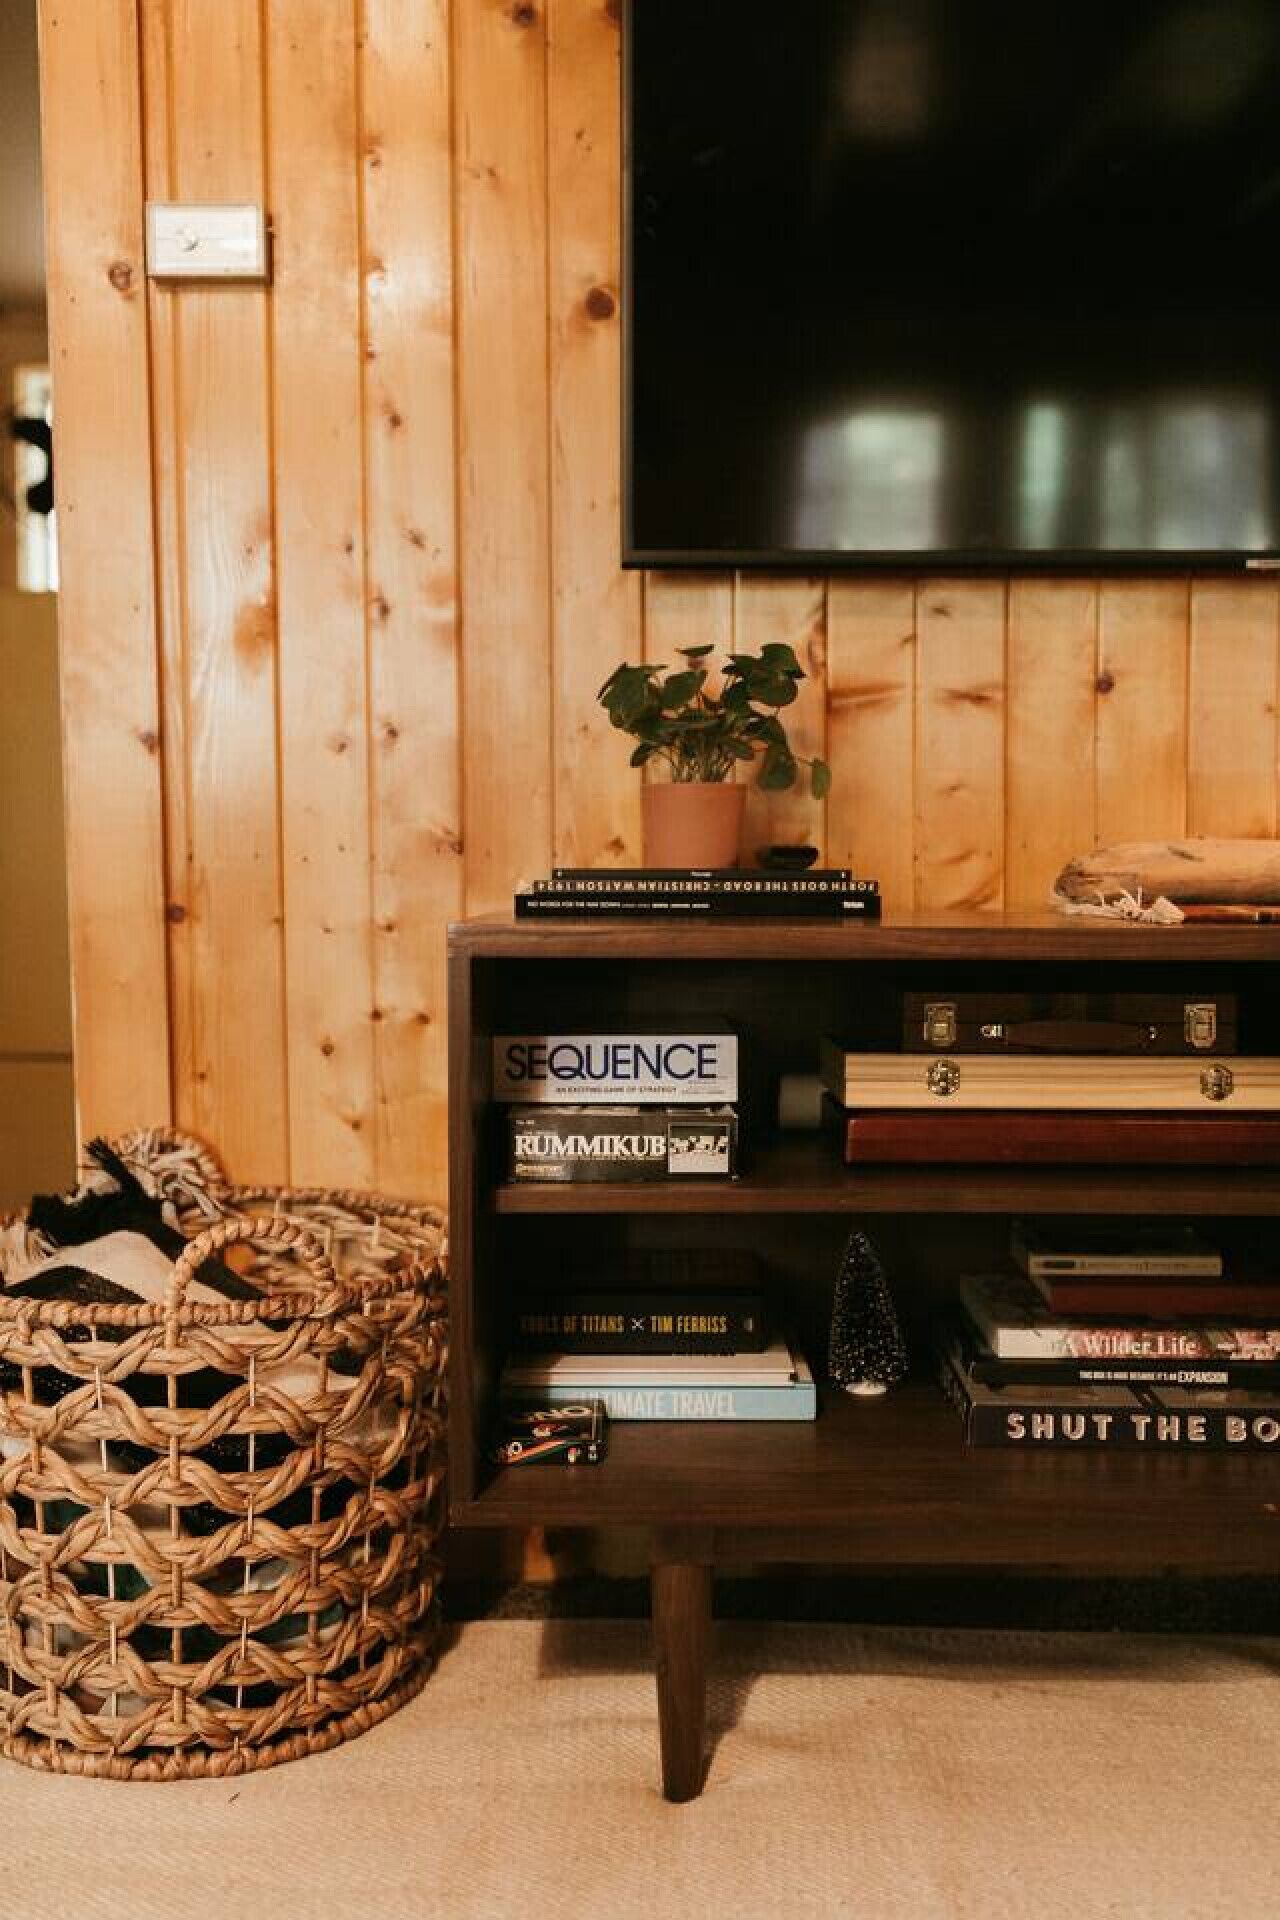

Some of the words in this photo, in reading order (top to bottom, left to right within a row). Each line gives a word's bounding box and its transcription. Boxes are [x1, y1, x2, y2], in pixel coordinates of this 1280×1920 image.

[576, 881, 634, 891] WATSON
[637, 881, 711, 891] CHRISTIAN
[724, 881, 761, 891] ROAD
[766, 881, 787, 891] THE
[505, 1043, 718, 1080] SEQUENCE
[514, 1135, 667, 1156] RUMMIKUB
[582, 1315, 625, 1333] TITANS
[651, 1315, 673, 1333] TIM
[677, 1315, 727, 1333] FERRISS
[1085, 1335, 1152, 1355] Wilder
[1157, 1335, 1198, 1355] Life
[672, 1391, 736, 1417] TRAVEL
[1007, 1412, 1113, 1441] SHUT
[1130, 1414, 1207, 1442] THE
